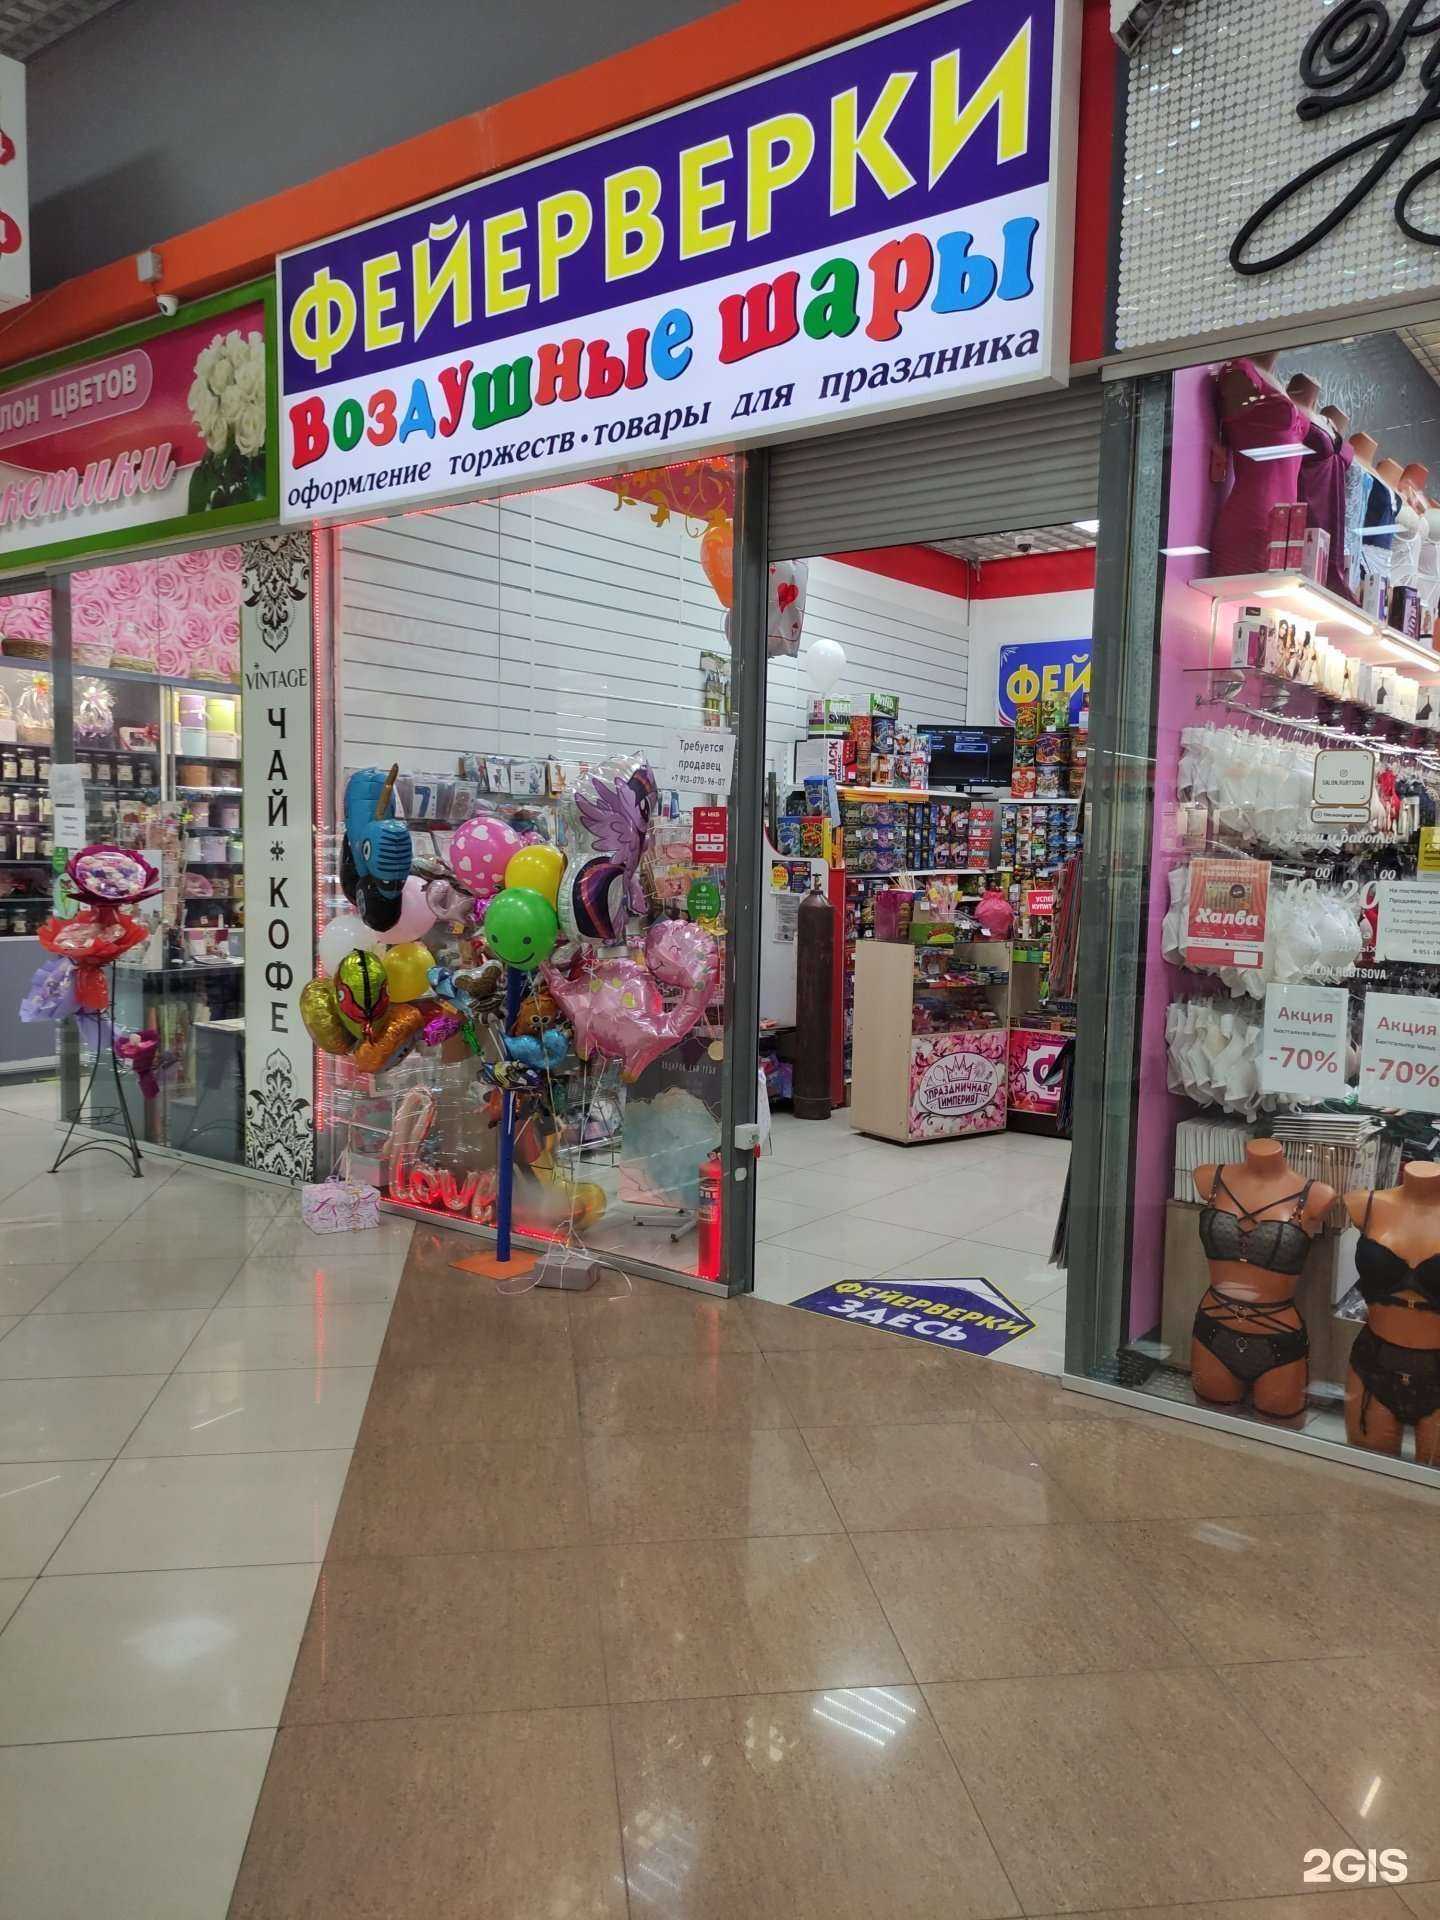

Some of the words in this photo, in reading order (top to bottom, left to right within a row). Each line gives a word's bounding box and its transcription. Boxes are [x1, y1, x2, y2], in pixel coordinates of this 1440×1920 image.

[290, 16, 1032, 373] ФЕЙЕРВЕРКИ
[719, 217, 1039, 364] шары
[51, 364, 137, 419] ЦВЕТОВ
[287, 461, 432, 508] оформление
[448, 430, 575, 478] торжеств
[593, 403, 711, 448] товары
[731, 381, 793, 421] для
[819, 328, 1039, 405] праздника
[245, 667, 308, 690] VINTAGE
[680, 740, 724, 753] Требуется
[267, 707, 288, 827] ЧАЙ
[679, 760, 721, 772] продавец
[1341, 831, 1398, 846] работы
[1380, 869, 1397, 880] 00
[1195, 908, 1259, 926] Халва
[265, 876, 294, 1034] КОФЕ
[1278, 1006, 1333, 1025] Акция
[1377, 1016, 1437, 1036] Акция
[1269, 1046, 1338, 1073] -70%
[1365, 1058, 1440, 1087] -70%
[928, 1082, 988, 1100] ПРАЗДНИЧНАЯ
[941, 1094, 975, 1107] ИМПЕРИЯ
[828, 1299, 968, 1342] ЗДЕСЬ
[834, 1282, 1028, 1335] ФЕЙЕРВЕРКИ
